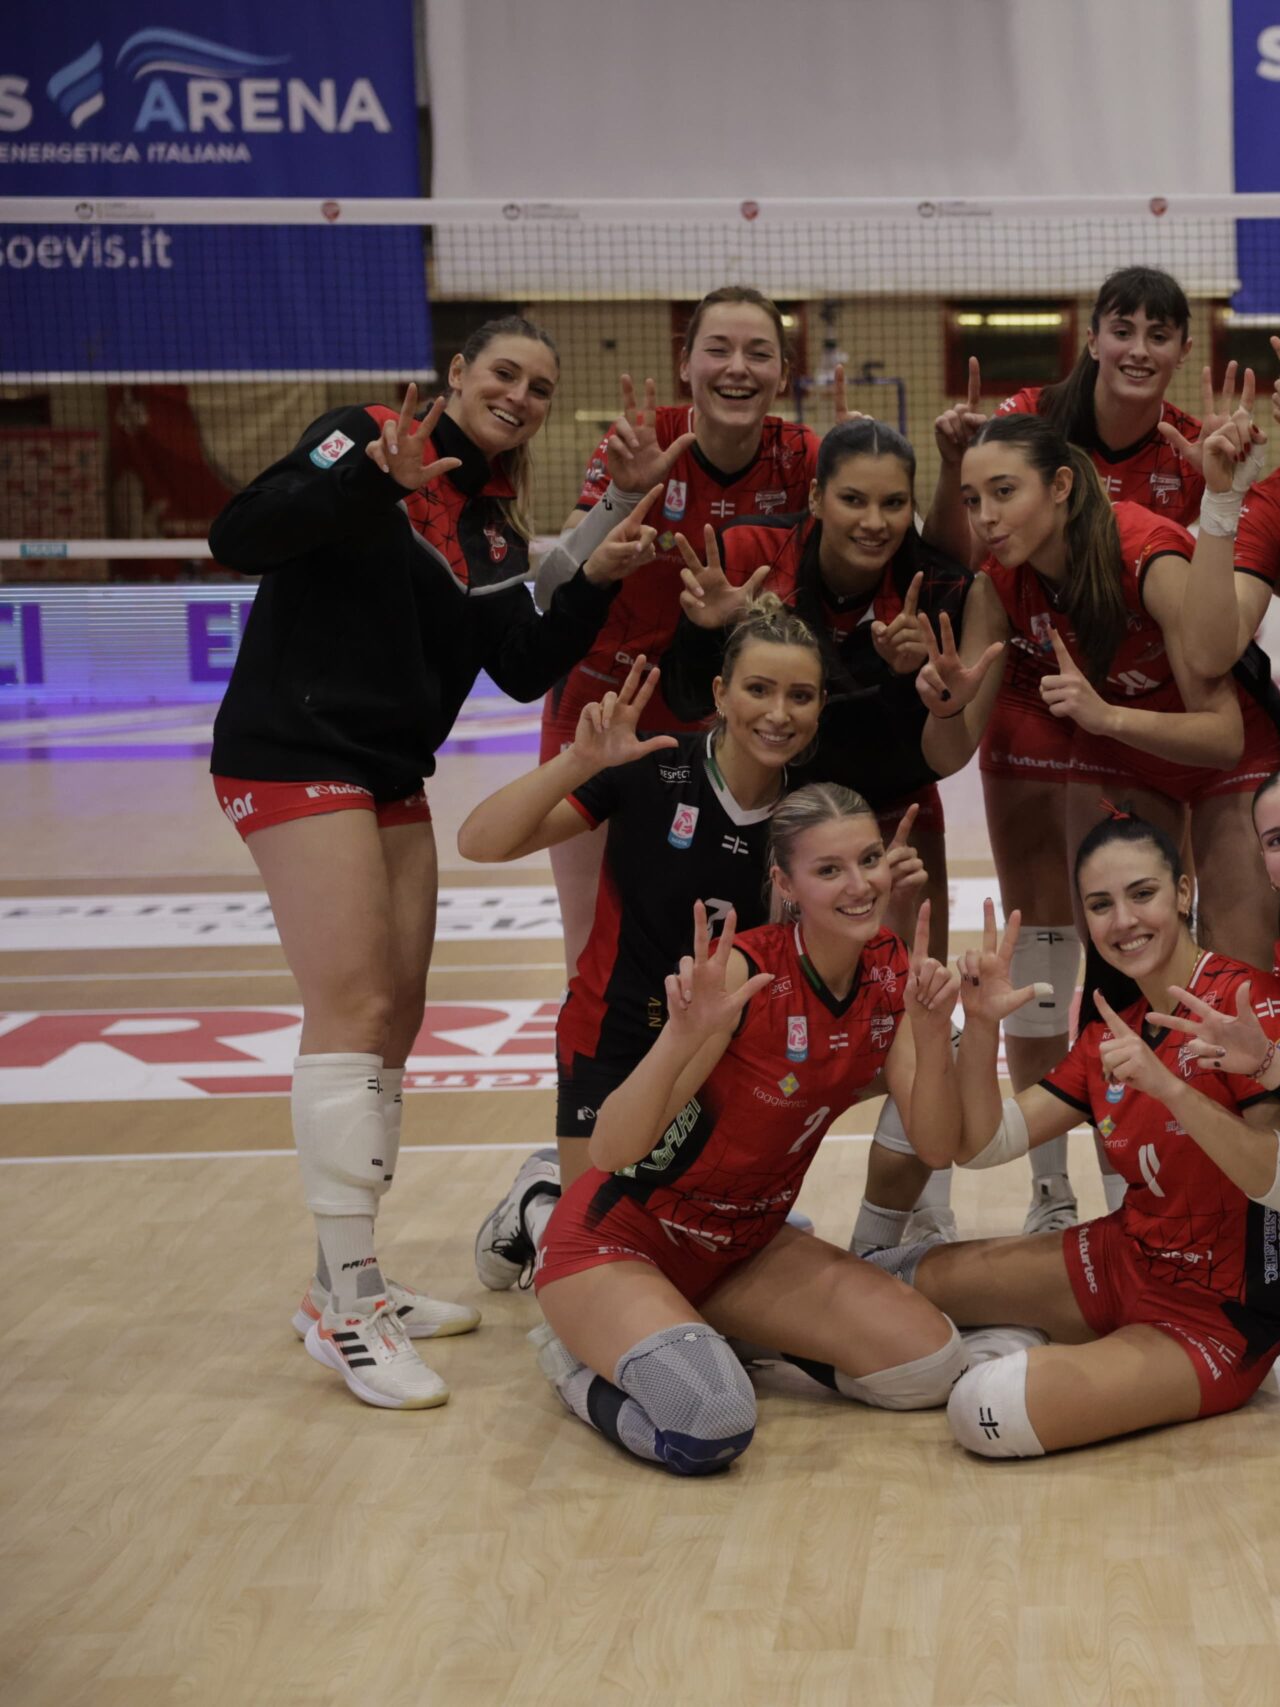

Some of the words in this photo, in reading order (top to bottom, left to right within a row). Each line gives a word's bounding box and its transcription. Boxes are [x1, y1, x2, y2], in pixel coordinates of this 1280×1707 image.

[134, 77, 391, 133] ARENA
[147, 142, 252, 163] ITALIANA
[0, 226, 173, 269] oevis.it
